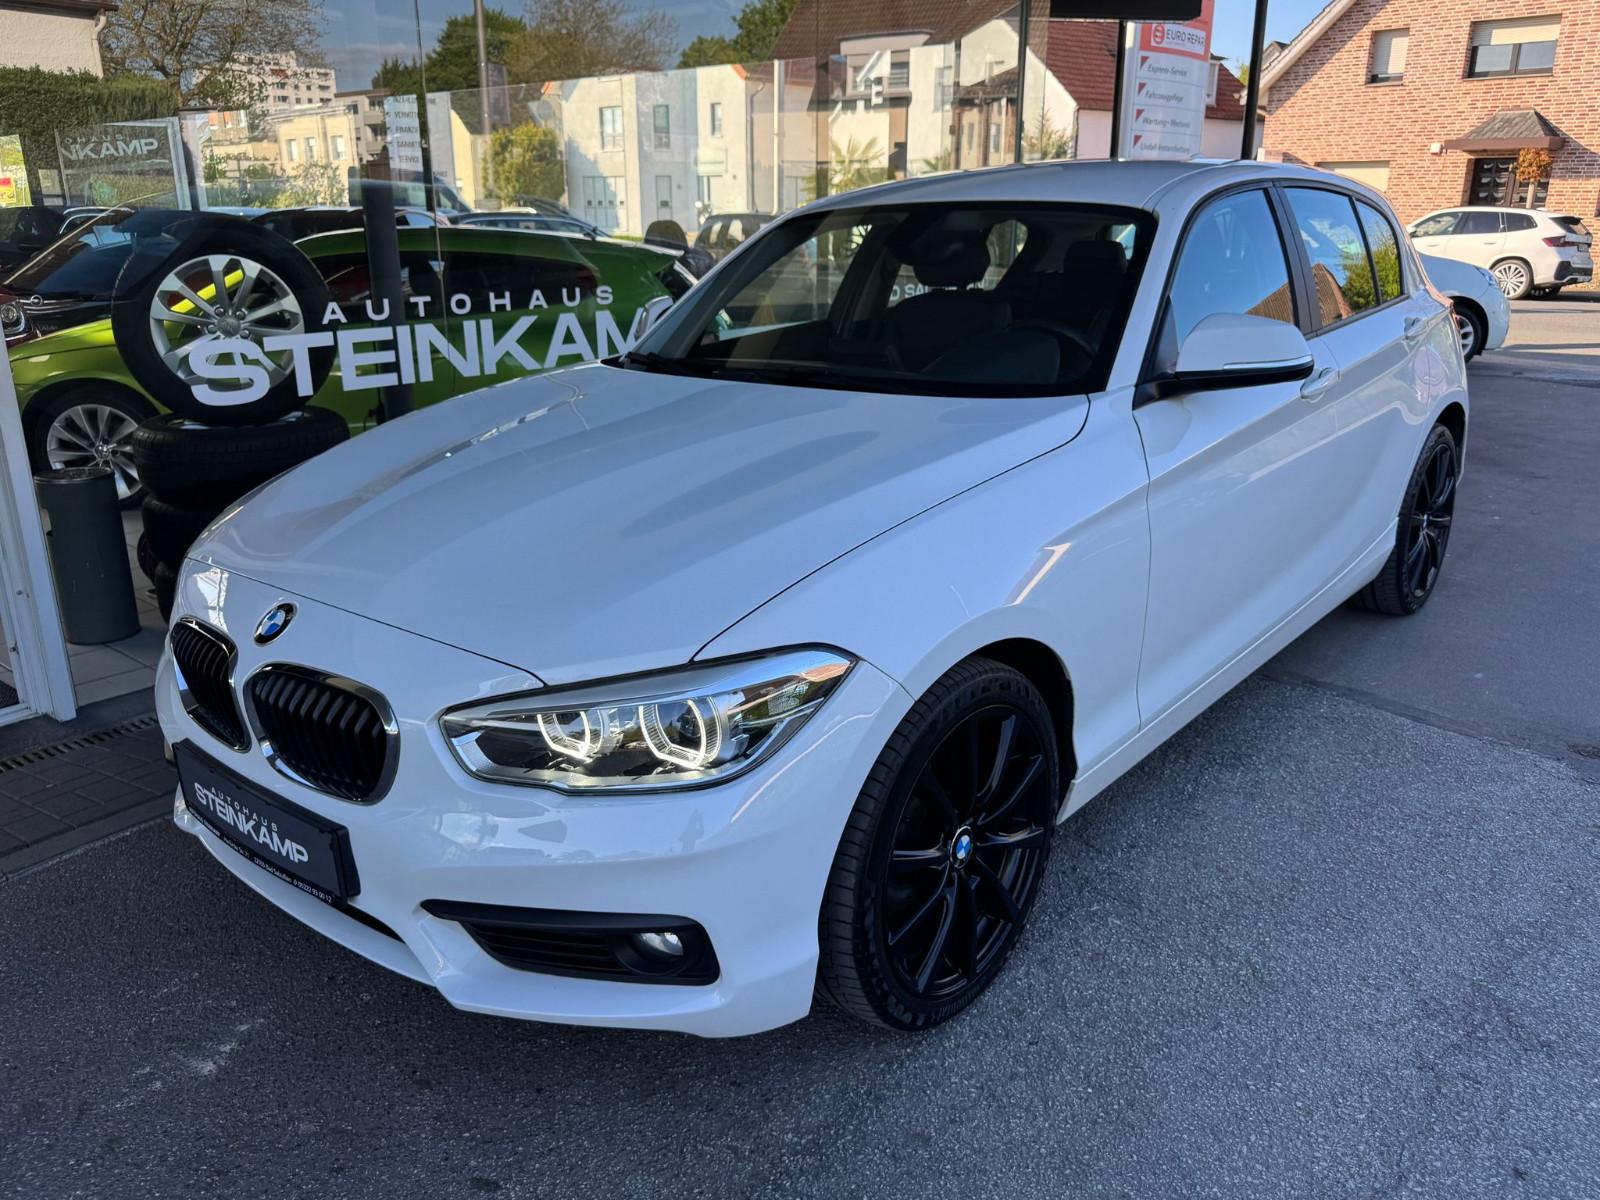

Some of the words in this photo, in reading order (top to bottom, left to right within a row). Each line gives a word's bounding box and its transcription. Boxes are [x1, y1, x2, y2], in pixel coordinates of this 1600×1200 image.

[1166, 29, 1187, 42] EURO
[322, 285, 614, 325] AUTOHAUS
[194, 782, 309, 864] STEINKAMP
[211, 786, 278, 832] AUTOHAUS
